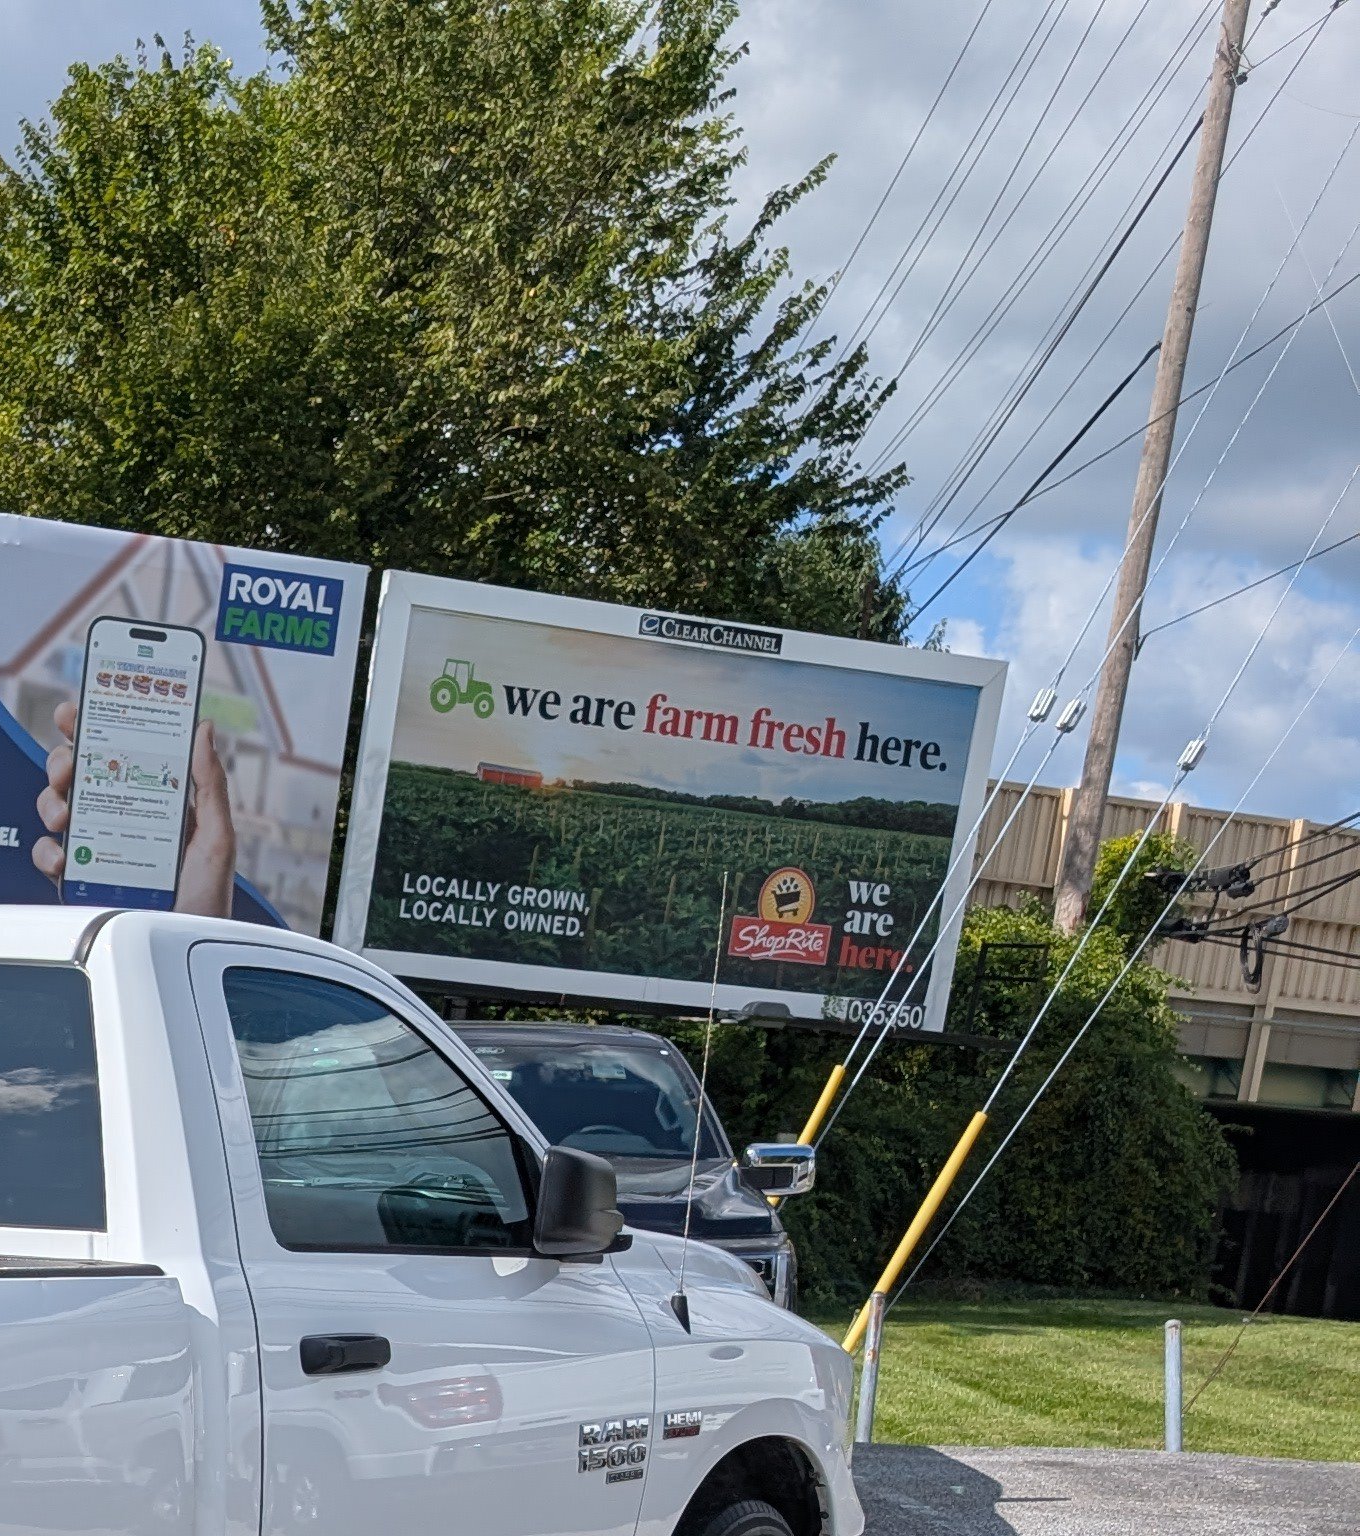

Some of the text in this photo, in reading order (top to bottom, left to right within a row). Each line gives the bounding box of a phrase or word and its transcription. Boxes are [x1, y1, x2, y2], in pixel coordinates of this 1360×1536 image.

[227, 572, 334, 616] ROYAL
[223, 606, 331, 649] FARMS
[502, 684, 948, 772] we are farm fresh here.
[402, 872, 591, 917] LOCALLY GROWN,
[847, 879, 892, 907] we
[398, 898, 585, 938] LOCALLY OWNED.
[843, 909, 895, 937] are
[735, 924, 824, 953] ShopRite
[579, 1417, 649, 1447] RAM
[665, 1411, 702, 1426] HEMI
[578, 1441, 647, 1473] 1500
